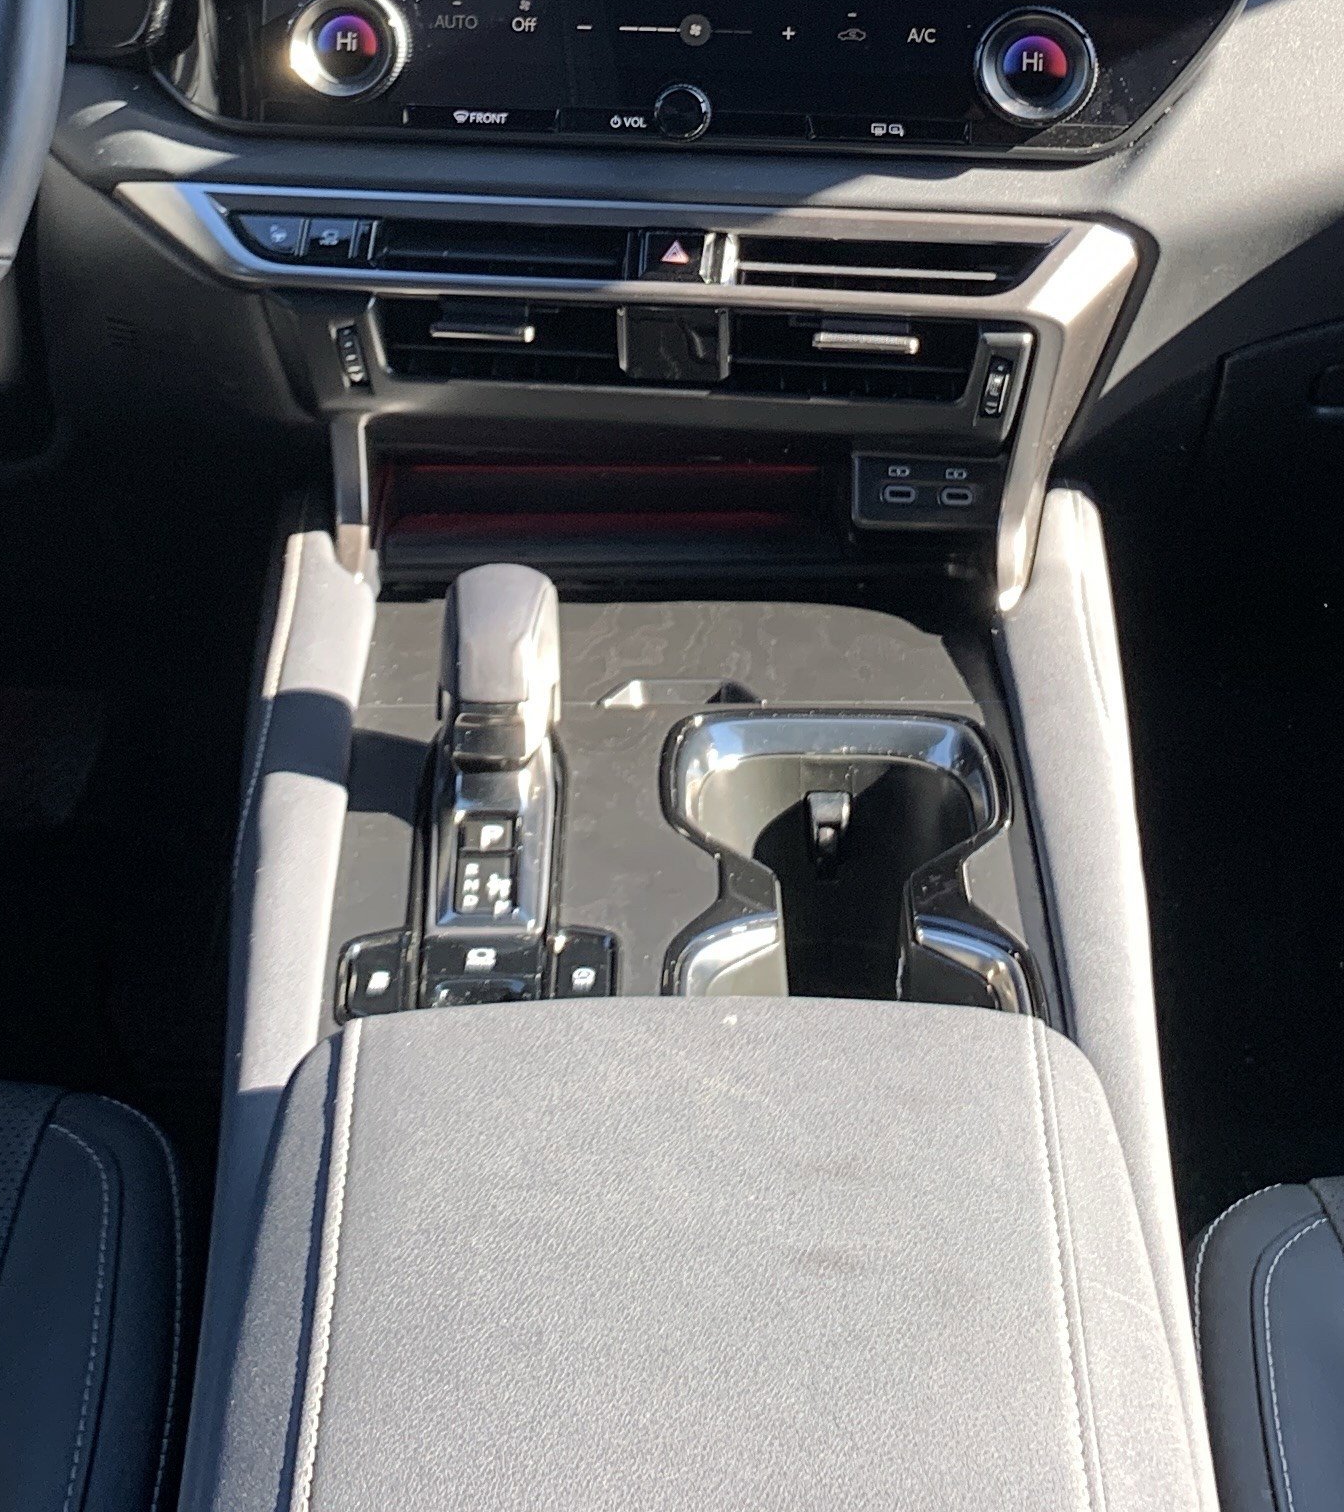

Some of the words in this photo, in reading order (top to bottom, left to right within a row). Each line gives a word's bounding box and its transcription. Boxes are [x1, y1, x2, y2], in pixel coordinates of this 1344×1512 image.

[434, 14, 479, 30] AUTO
[511, 16, 538, 33] Off
[336, 31, 358, 52] Hi
[906, 28, 937, 44] A/C
[1021, 51, 1044, 73] Hi
[469, 111, 509, 125] FRONT
[623, 116, 647, 129] VOL
[480, 824, 505, 850] P
